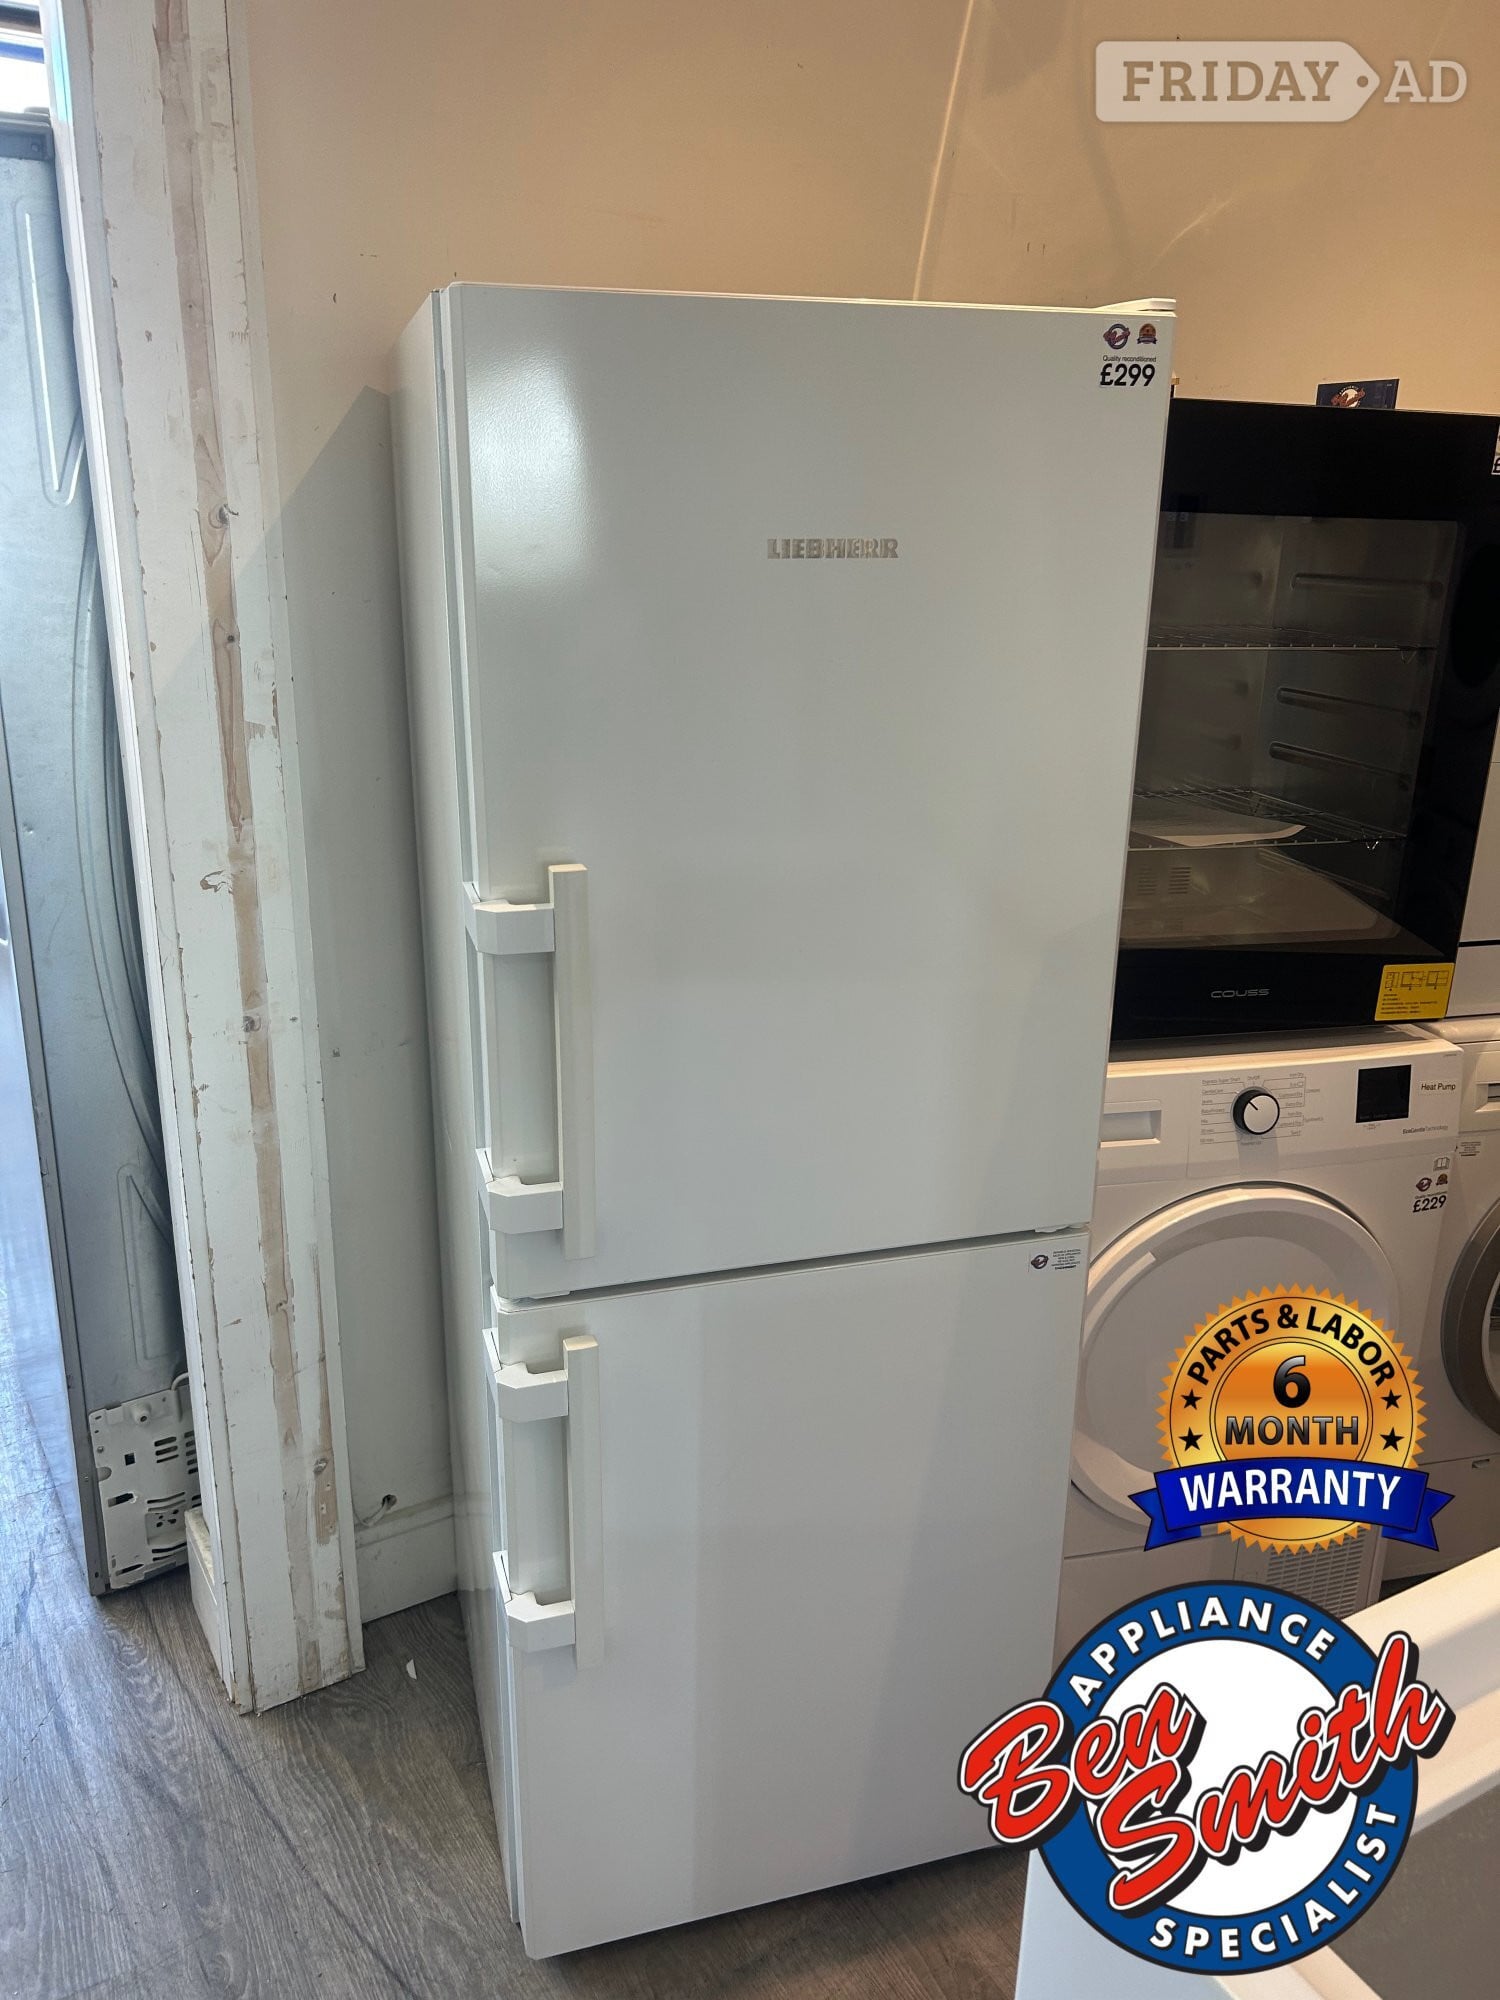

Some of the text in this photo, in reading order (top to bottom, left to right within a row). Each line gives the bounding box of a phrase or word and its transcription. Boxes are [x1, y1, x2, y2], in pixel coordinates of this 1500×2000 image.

[1100, 363, 1155, 386] £299
[767, 538, 899, 559] LIEBHERR
[1210, 988, 1271, 998] COUSS
[1421, 1082, 1456, 1091] Heat Pump
[1412, 1195, 1447, 1212] £229
